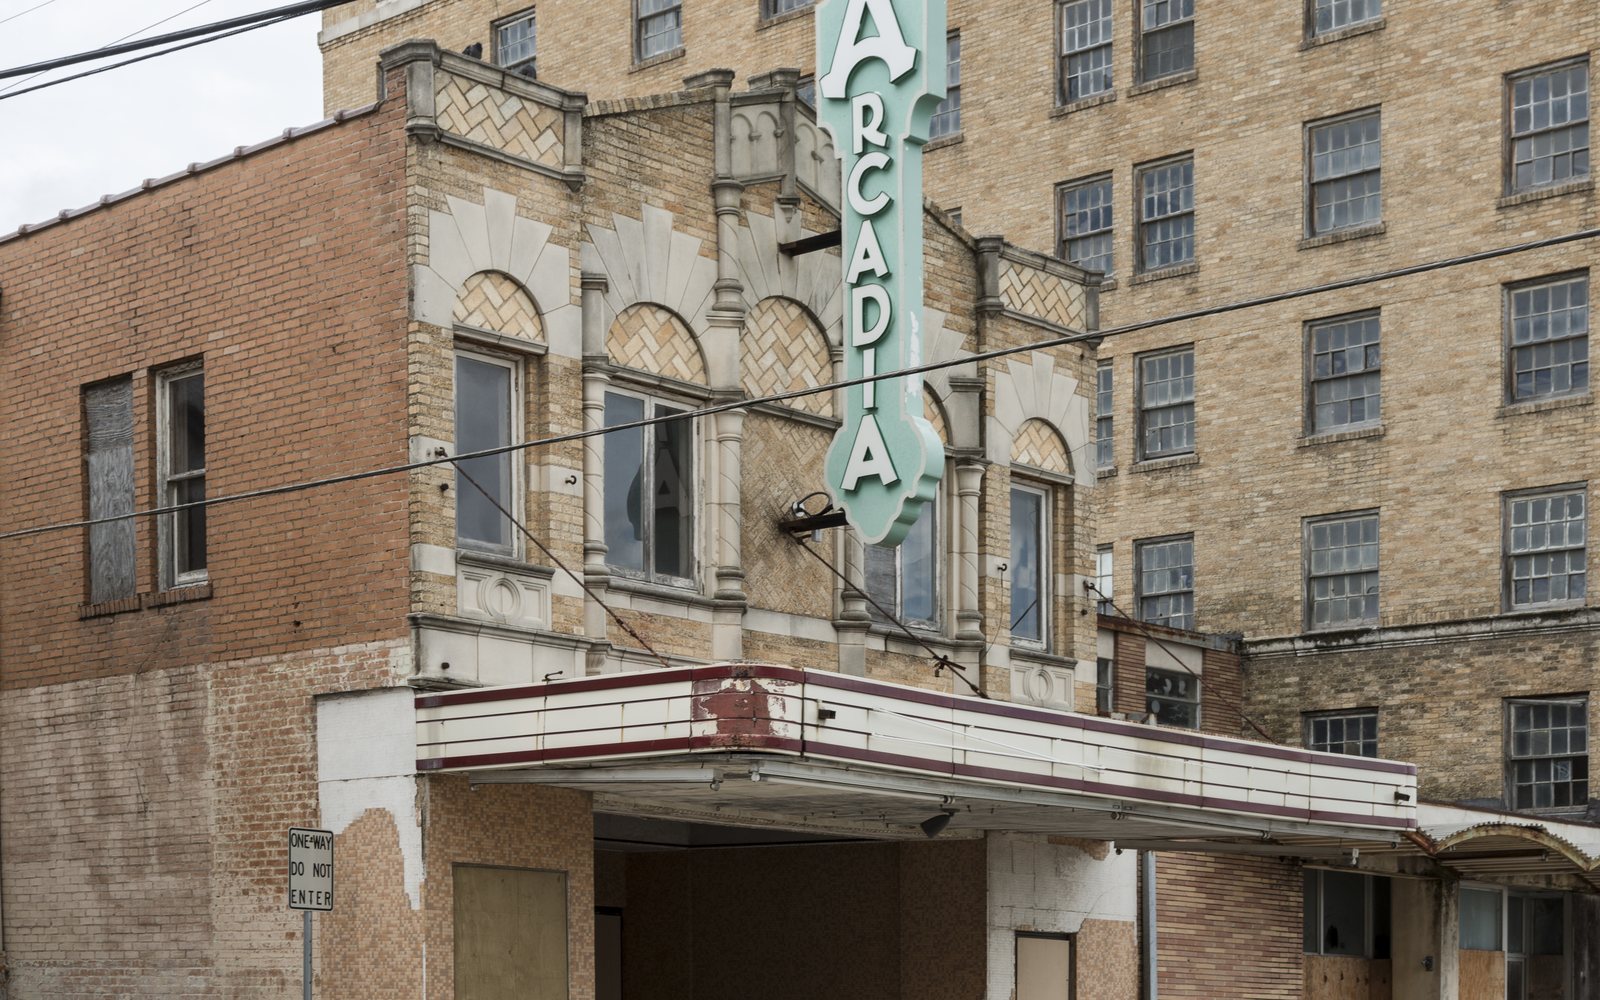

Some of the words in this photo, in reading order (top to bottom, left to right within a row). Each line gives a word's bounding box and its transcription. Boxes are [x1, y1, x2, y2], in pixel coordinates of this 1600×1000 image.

[819, 0, 918, 491] ARCADIA
[291, 861, 304, 876] DO
[313, 863, 331, 878] NOT
[291, 889, 331, 906] ENTER
